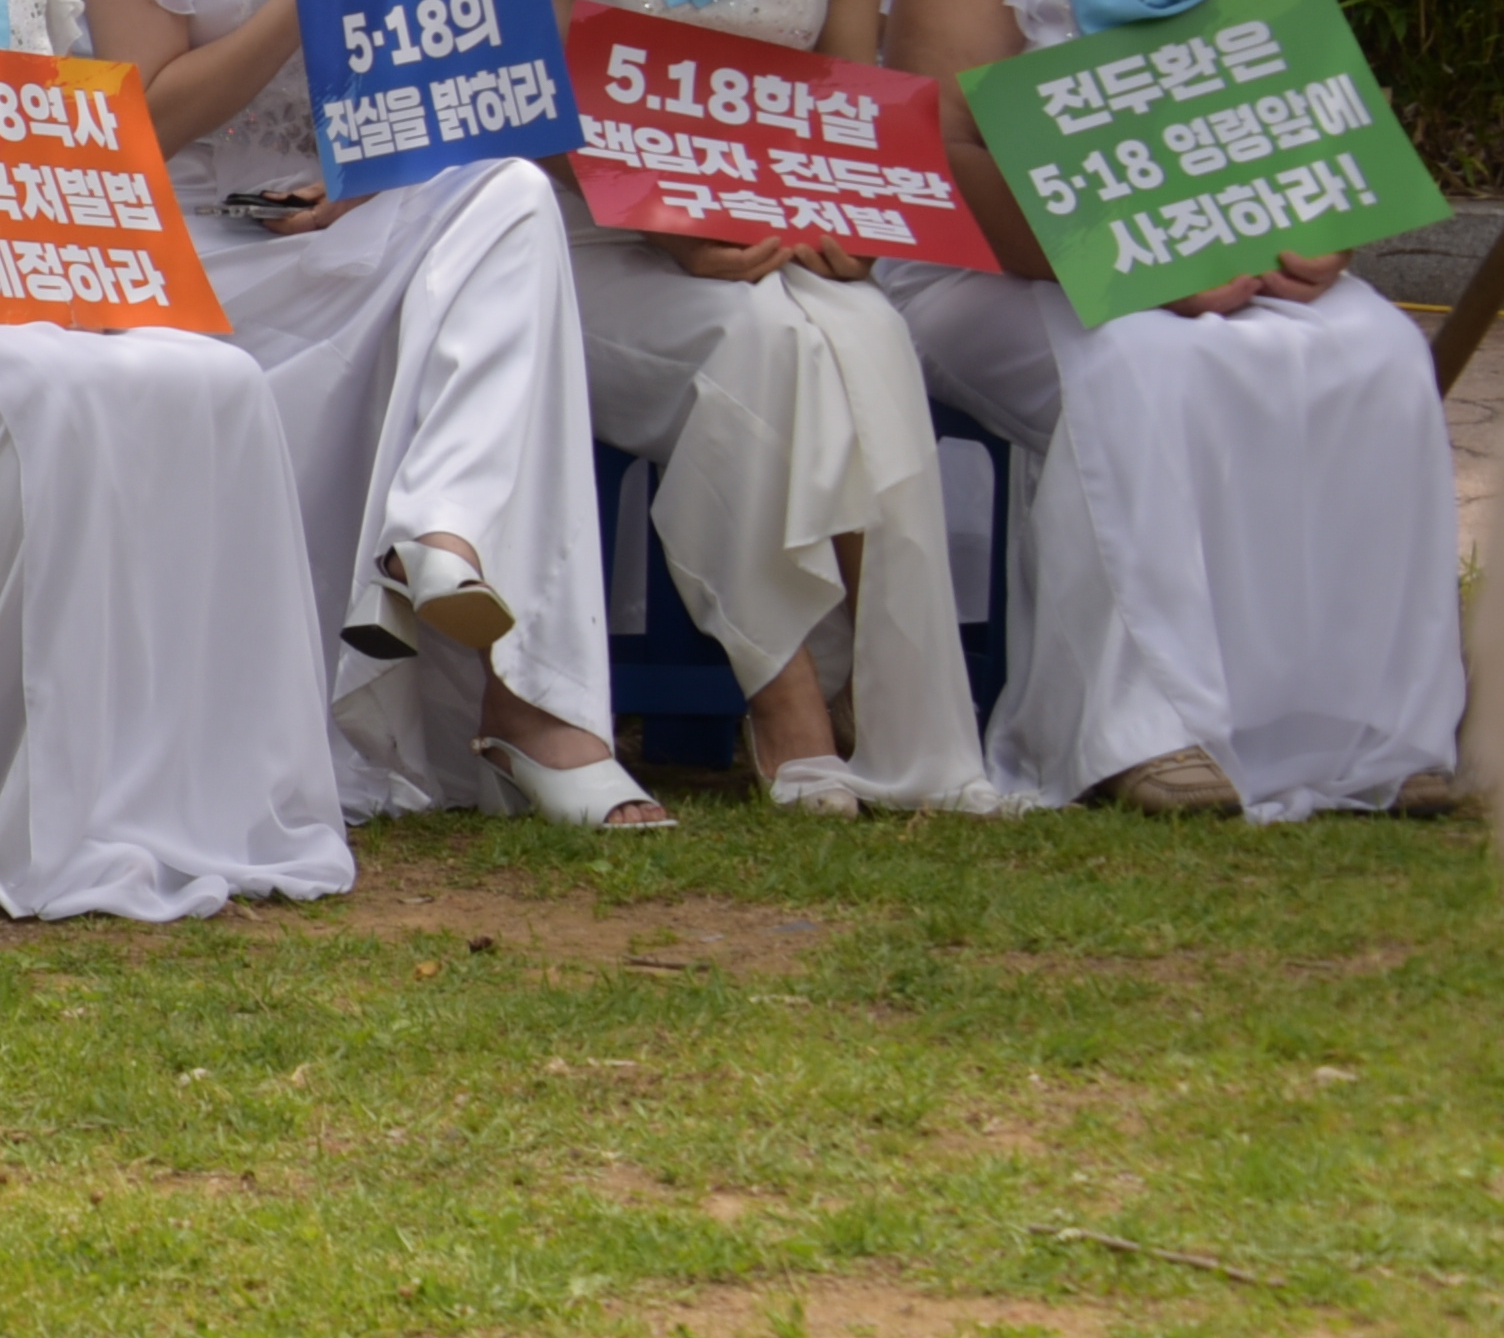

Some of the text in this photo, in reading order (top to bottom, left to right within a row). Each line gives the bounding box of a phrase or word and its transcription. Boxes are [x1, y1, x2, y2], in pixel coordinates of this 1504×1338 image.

[324, 61, 558, 164] 진실을 밝혀라
[603, 45, 878, 147] 5.18학살
[1035, 21, 1285, 137] 전두환은
[579, 112, 952, 211] 책임자 전두환
[1028, 69, 1374, 214] 5·18 영령앞에
[659, 172, 915, 245] 구속처벌
[1108, 154, 1378, 274] 사죄하라!
